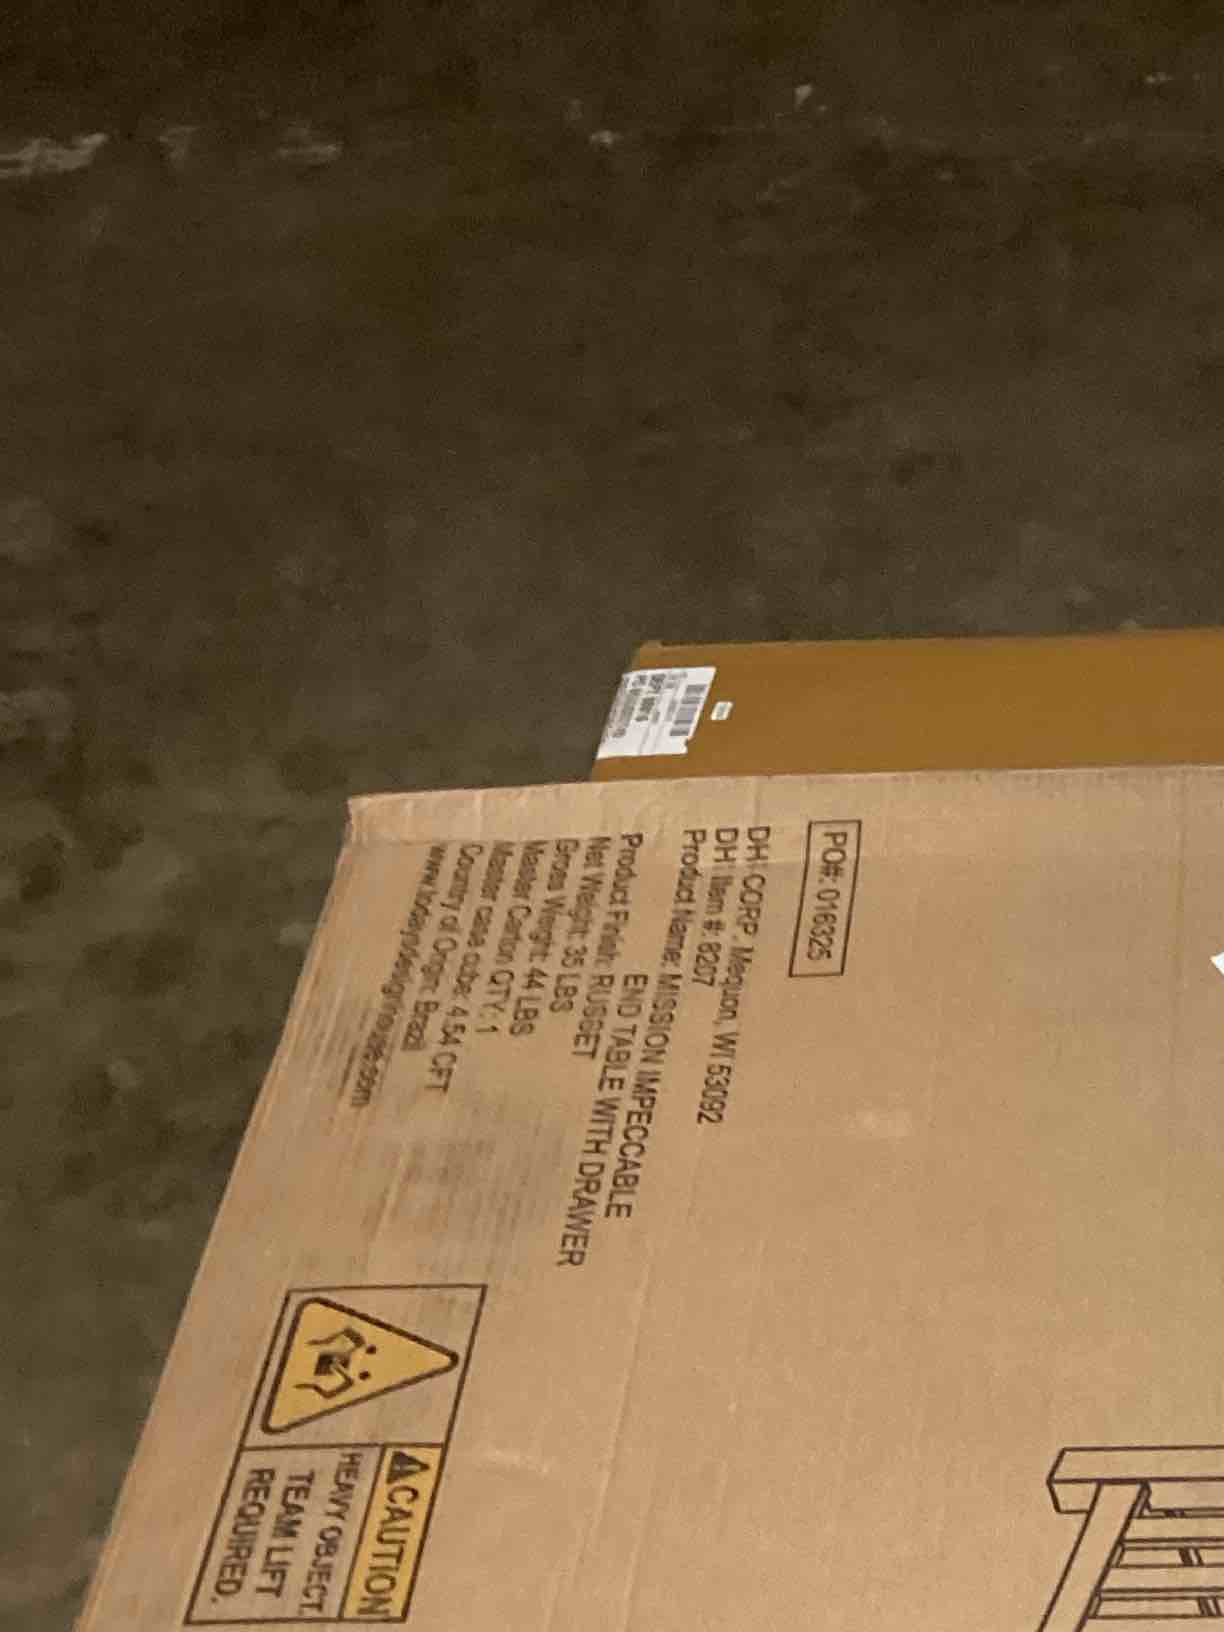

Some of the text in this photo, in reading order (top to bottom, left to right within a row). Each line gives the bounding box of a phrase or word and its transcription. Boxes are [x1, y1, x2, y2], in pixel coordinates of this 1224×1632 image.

[480, 840, 515, 901] Master
[512, 840, 548, 900] Master
[584, 836, 611, 869] Net
[609, 832, 643, 905] Product
[674, 829, 706, 904] Product
[496, 905, 531, 965] Carton
[807, 888, 841, 961] 016325
[521, 967, 548, 990] 44
[561, 945, 588, 968] 35
[692, 941, 722, 987] 8207
[508, 996, 542, 1036] LBS
[549, 973, 581, 1013] LBS
[640, 973, 682, 1065] MISSION
[424, 1052, 457, 1093] CFT
[710, 1032, 739, 1059] WI
[557, 974, 648, 1267] END TABLE WITH DRAWER
[697, 1063, 731, 1124] 53092
[604, 1070, 661, 1218] IMPECCABLE
[324, 1452, 363, 1521] HEAVY
[210, 1467, 276, 1605] REQUIRED.
[255, 1469, 315, 1598] TEAM LIFT
[357, 1485, 421, 1616] CAUTION
